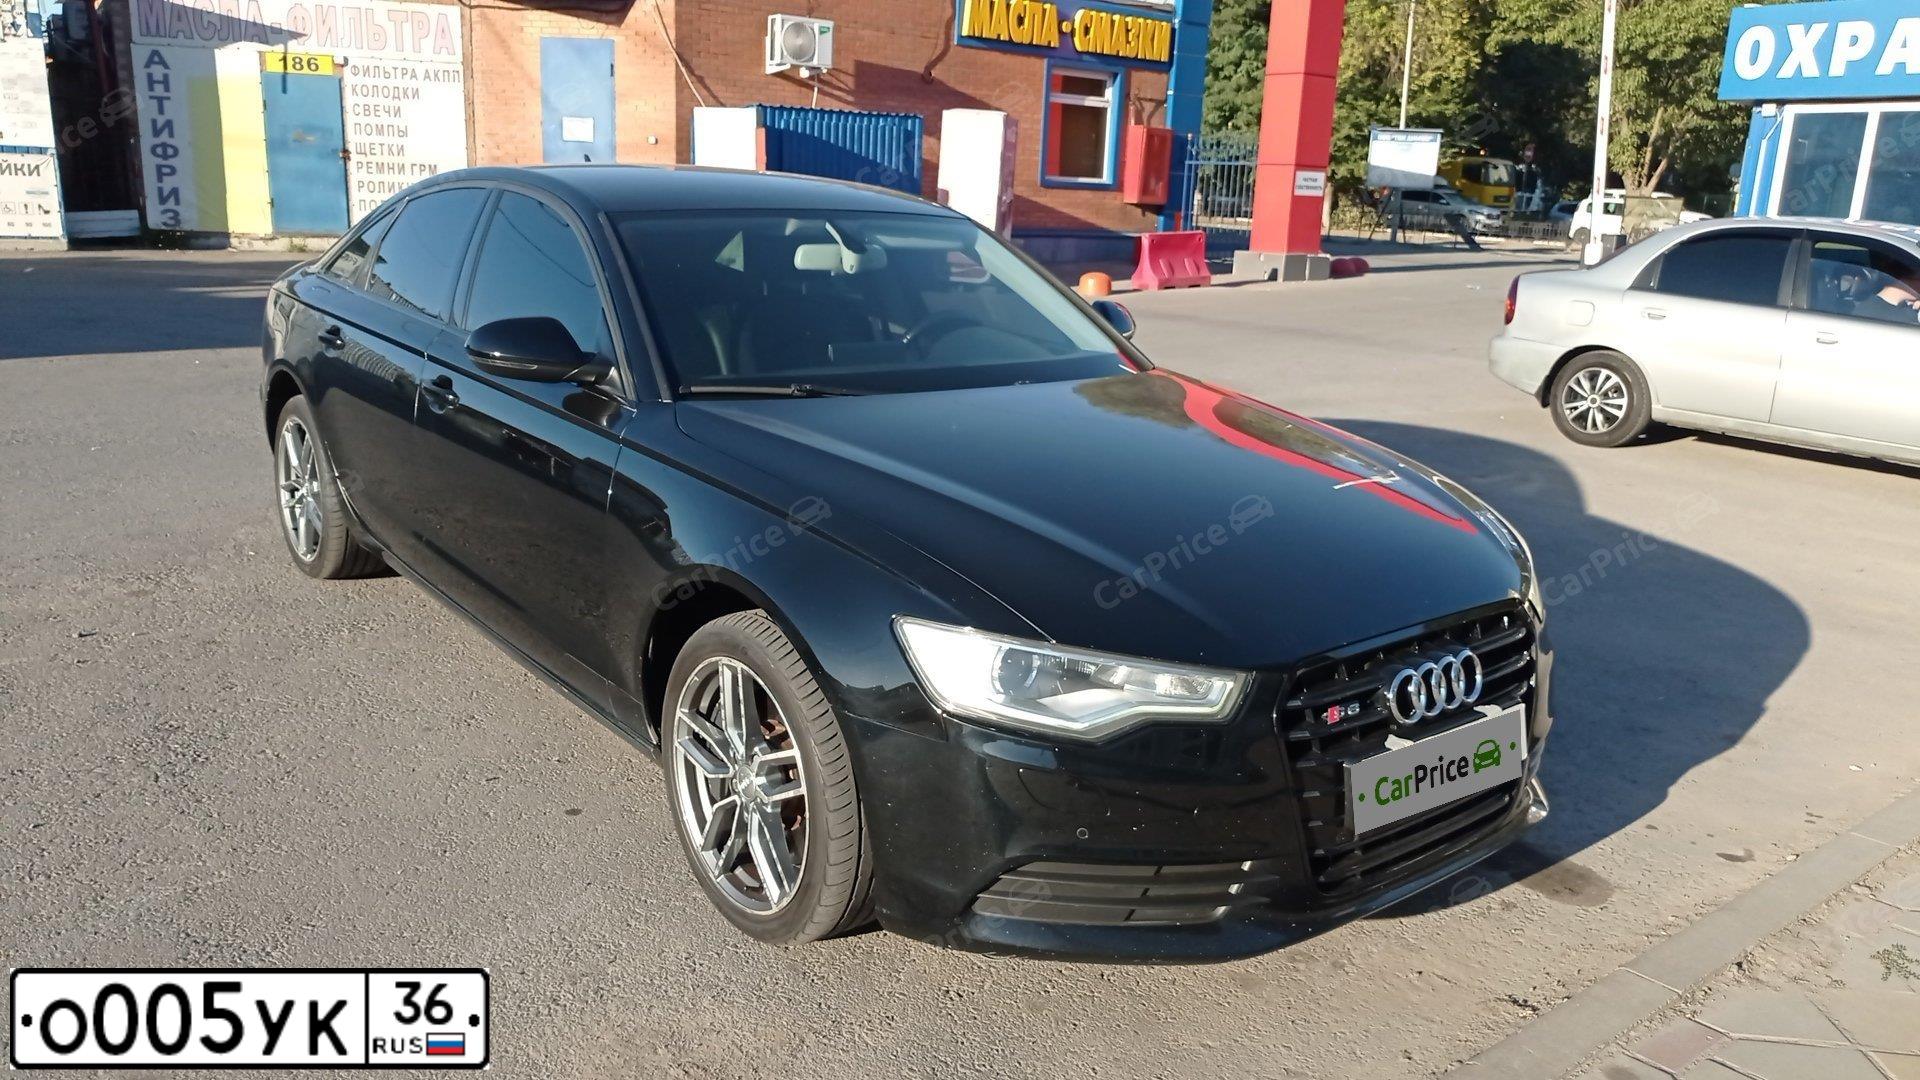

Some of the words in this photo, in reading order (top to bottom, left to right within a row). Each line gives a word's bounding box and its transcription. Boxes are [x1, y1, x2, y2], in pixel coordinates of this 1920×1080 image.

[962, 0, 1060, 47] МАСЛА
[1074, 9, 1172, 62] СМАЗКИ
[1734, 17, 1920, 81] ОХРА
[278, 55, 320, 73] 186
[350, 65, 418, 81] ФИЛЬТРА
[423, 69, 461, 83] АКПП
[351, 83, 420, 101] КОЛОДКИ
[353, 103, 402, 118] СВЕЧИ
[143, 49, 182, 229] АНТИФРИЗ
[354, 123, 408, 138] ПОМПЫ
[355, 142, 405, 157] ЩЕТКИ
[356, 161, 406, 175] РЕМНИ
[410, 163, 438, 177] ГРМ
[357, 180, 413, 194] РОЛИК
